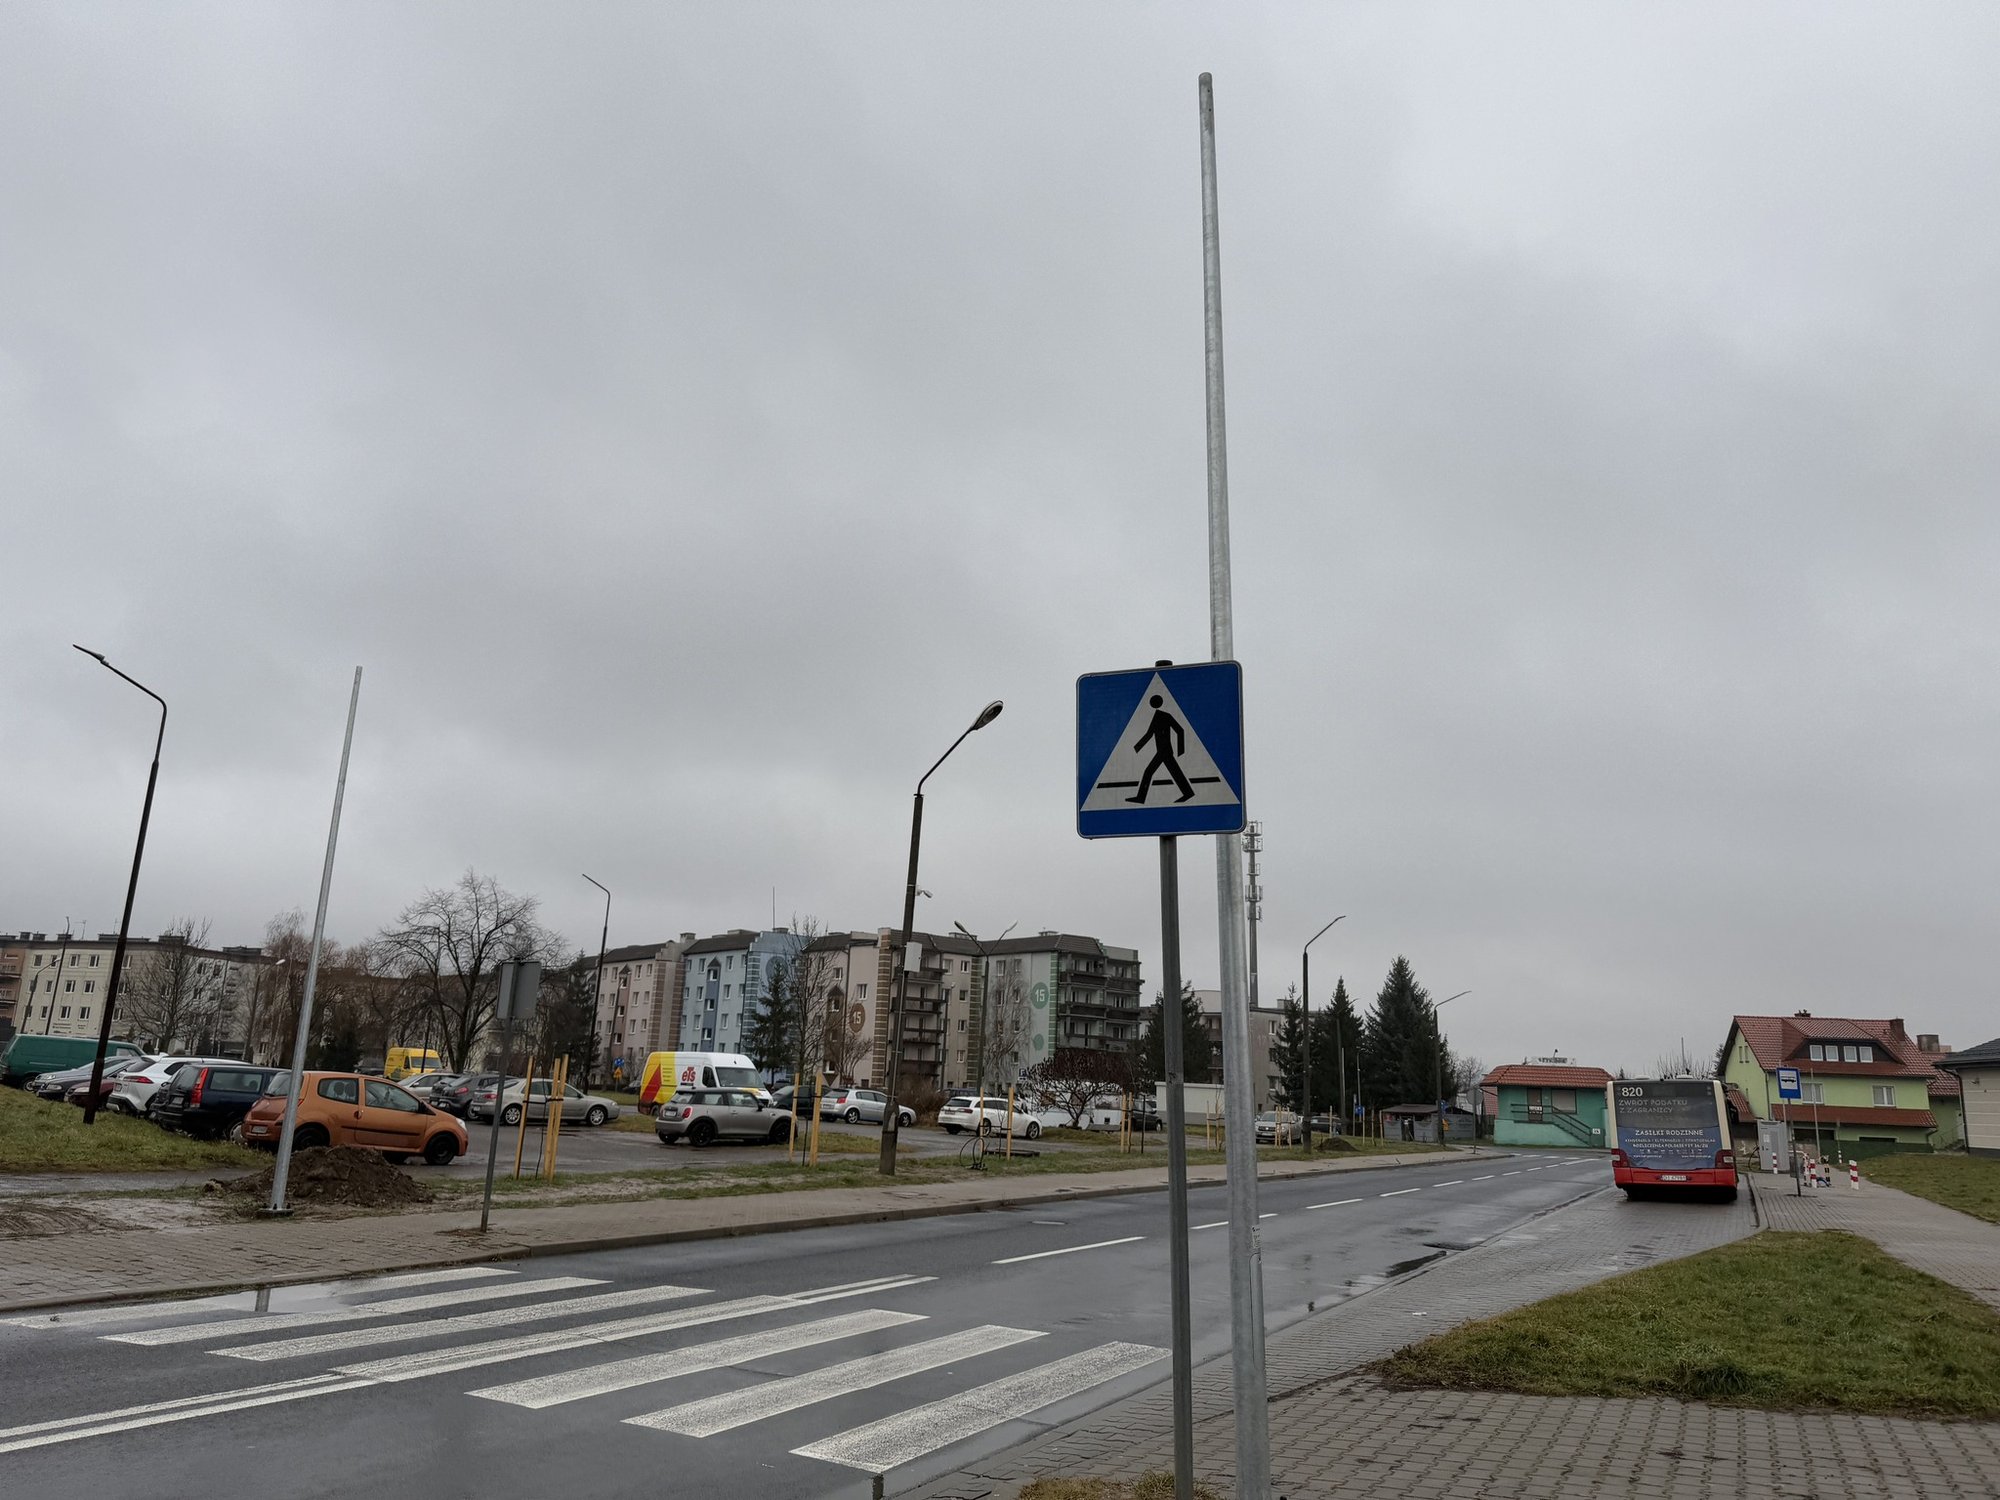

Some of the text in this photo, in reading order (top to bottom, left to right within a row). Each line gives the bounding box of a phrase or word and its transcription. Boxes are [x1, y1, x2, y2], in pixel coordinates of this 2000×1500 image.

[1035, 989, 1045, 1002] 15
[852, 1011, 862, 1024] 15
[1621, 1087, 1643, 1097] 820
